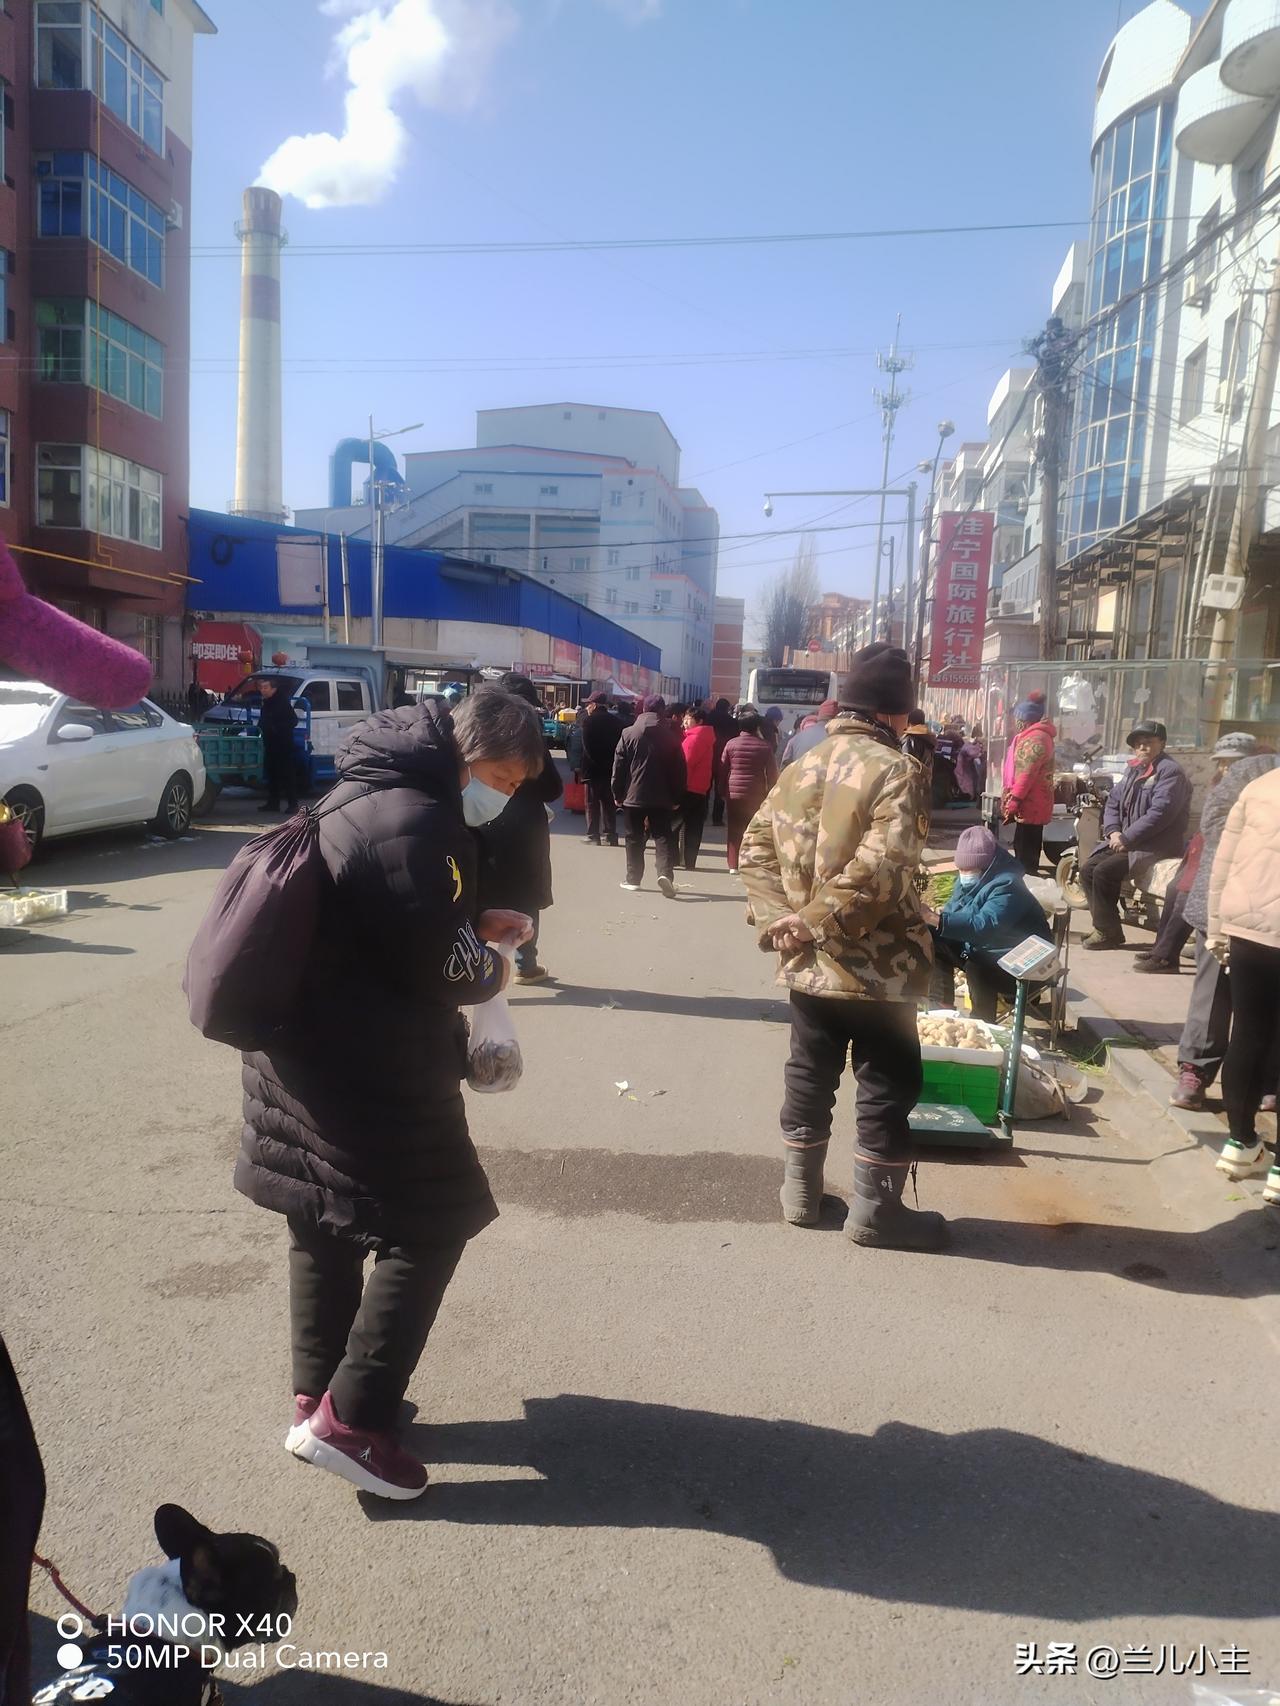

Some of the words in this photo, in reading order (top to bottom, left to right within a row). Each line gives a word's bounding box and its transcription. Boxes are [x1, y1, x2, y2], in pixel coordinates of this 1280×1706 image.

[942, 515, 984, 669] 佳宁国际旅行社
